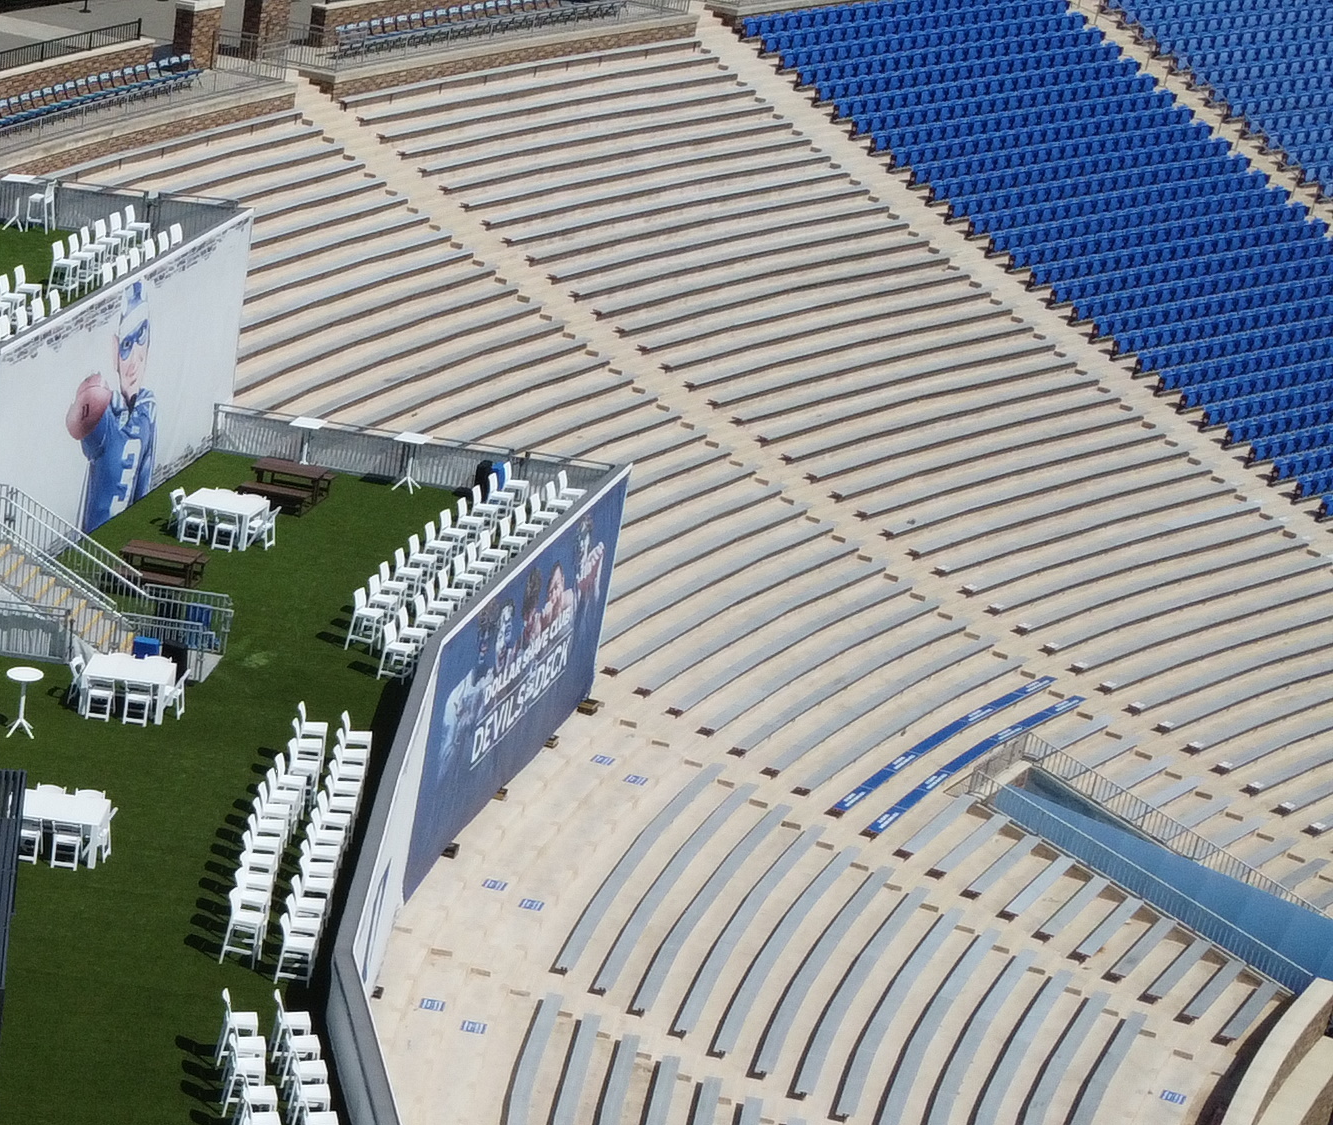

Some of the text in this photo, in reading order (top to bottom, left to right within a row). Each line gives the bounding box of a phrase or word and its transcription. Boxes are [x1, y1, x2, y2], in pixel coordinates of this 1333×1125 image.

[470, 634, 573, 764] DEVILS DECK
[484, 606, 574, 706] DOLLAR SHAVE CLUB
